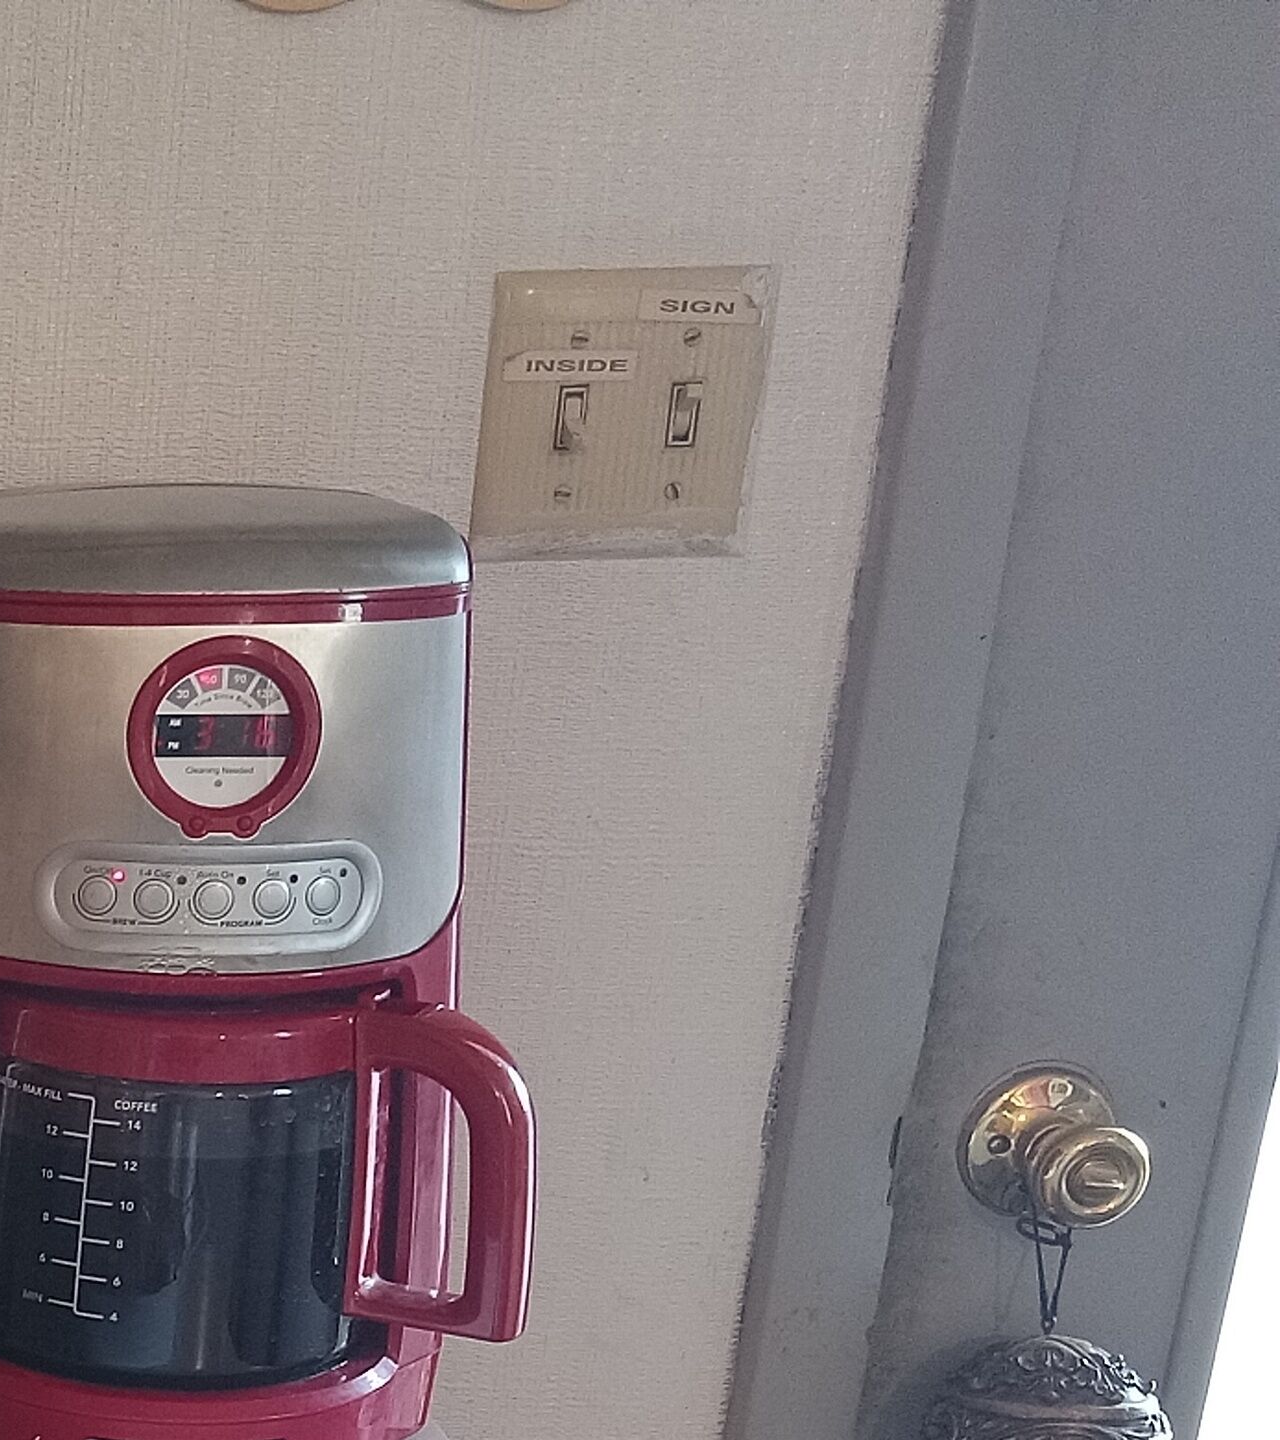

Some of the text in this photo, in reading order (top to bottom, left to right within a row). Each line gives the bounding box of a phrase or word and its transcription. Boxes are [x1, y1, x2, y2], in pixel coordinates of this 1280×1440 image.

[659, 299, 736, 315] SIGN
[526, 358, 629, 373] INSIDE
[185, 766, 255, 776] Cleaning Needed
[220, 919, 264, 928] PROGRAM
[114, 1099, 158, 1114] COFFEE
[45, 1124, 58, 1136] 12
[127, 1120, 141, 1131] 14
[123, 1160, 138, 1172] 12
[41, 1168, 53, 1180] 10
[120, 1201, 135, 1212] 10
[116, 1239, 124, 1250] 8
[112, 1276, 122, 1287] 6
[109, 1312, 118, 1322] 4
